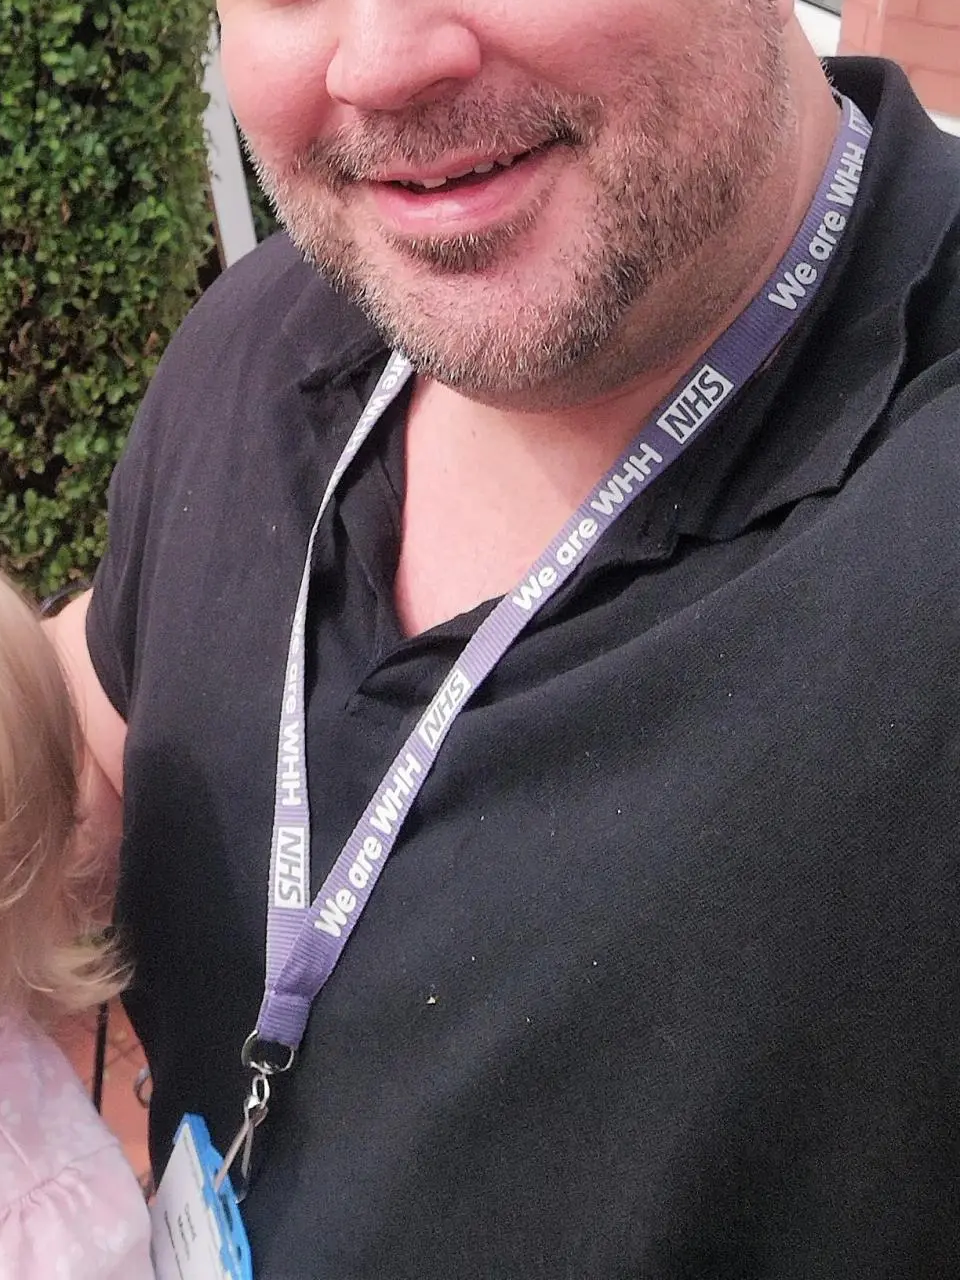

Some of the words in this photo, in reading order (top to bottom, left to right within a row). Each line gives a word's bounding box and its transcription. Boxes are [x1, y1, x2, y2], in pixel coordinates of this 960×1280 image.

[826, 142, 866, 207] WHH
[809, 210, 847, 261] are
[768, 262, 818, 310] We
[662, 370, 728, 441] NHS
[514, 563, 557, 611] We
[556, 518, 598, 566] are
[591, 443, 663, 516] WHH
[422, 672, 468, 745] NHS
[281, 722, 302, 807] WHH
[279, 831, 302, 905] NHS
[314, 889, 357, 938] We
[349, 836, 383, 889] are
[370, 753, 421, 835] WHH
